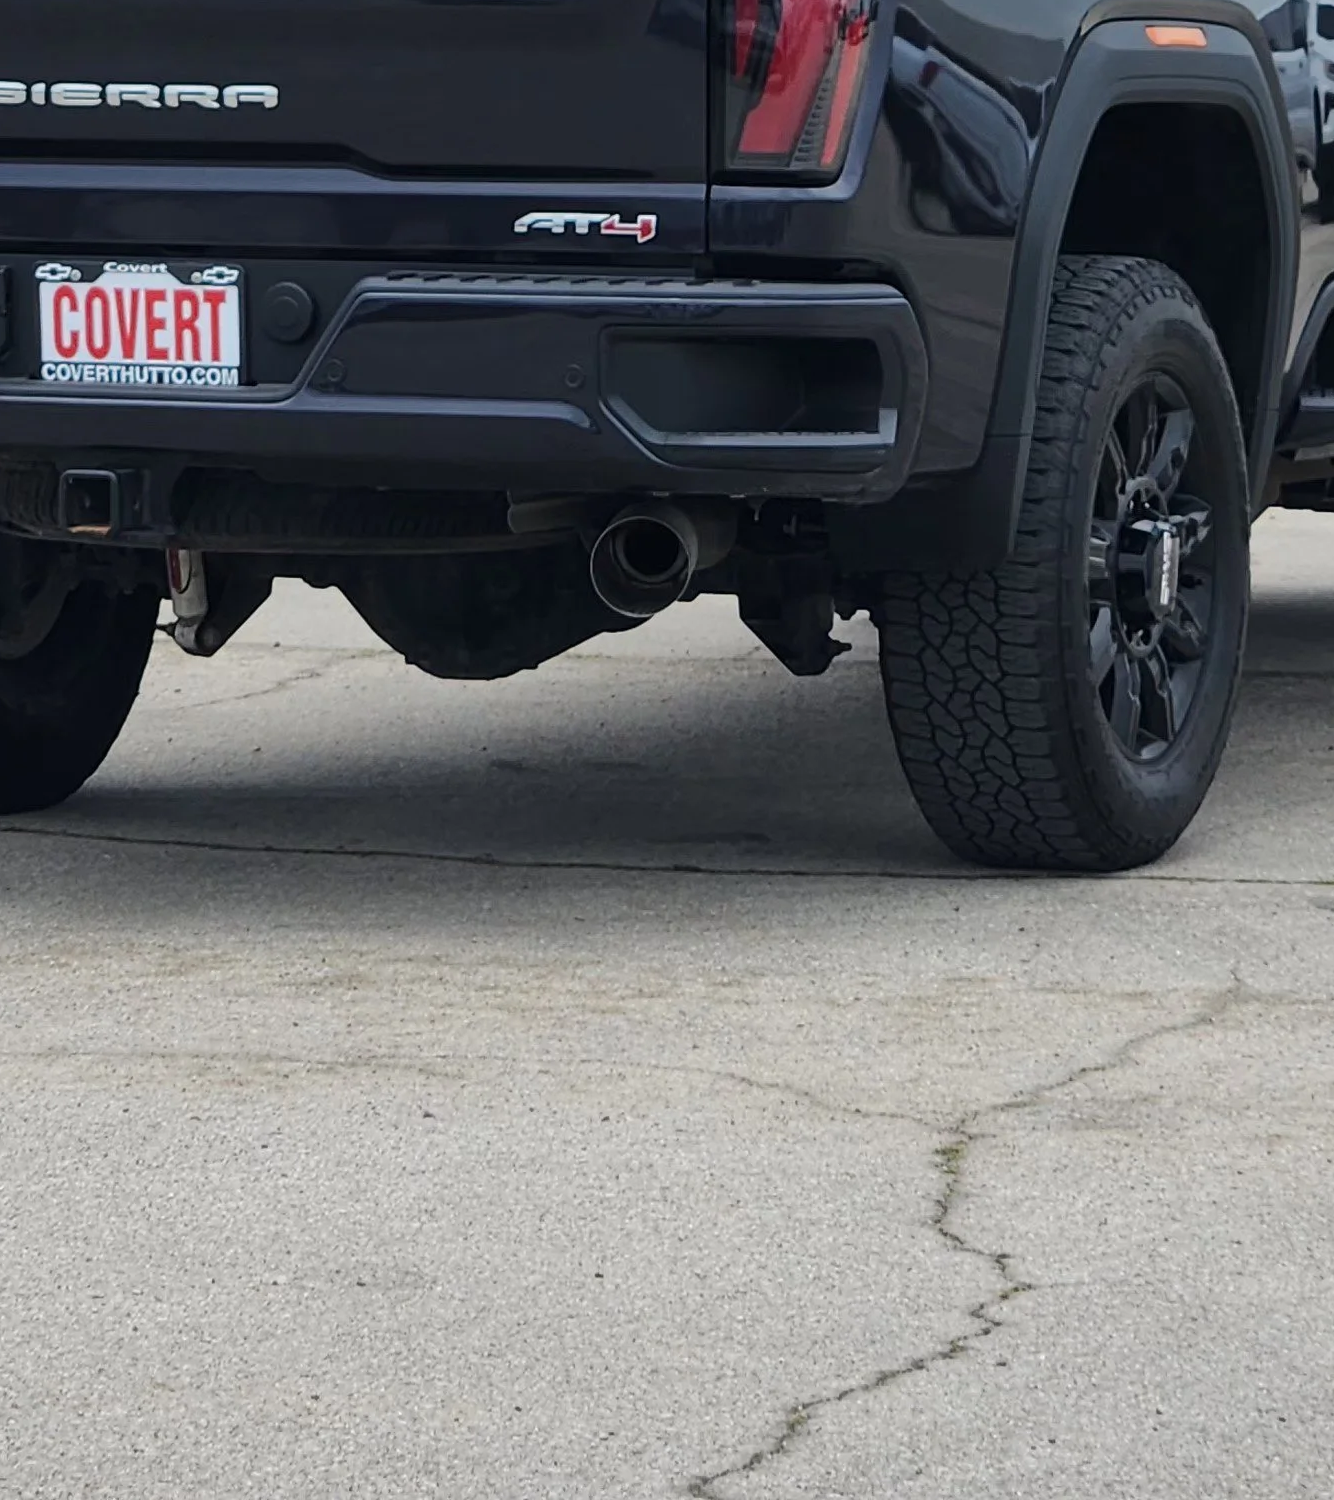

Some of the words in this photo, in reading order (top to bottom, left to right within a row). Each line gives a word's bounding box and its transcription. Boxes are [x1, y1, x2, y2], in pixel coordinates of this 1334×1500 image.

[513, 211, 658, 244] AT4
[102, 261, 169, 274] Covert
[52, 285, 227, 363] COVERT
[41, 362, 239, 387] COVERTHUTTO.COM
